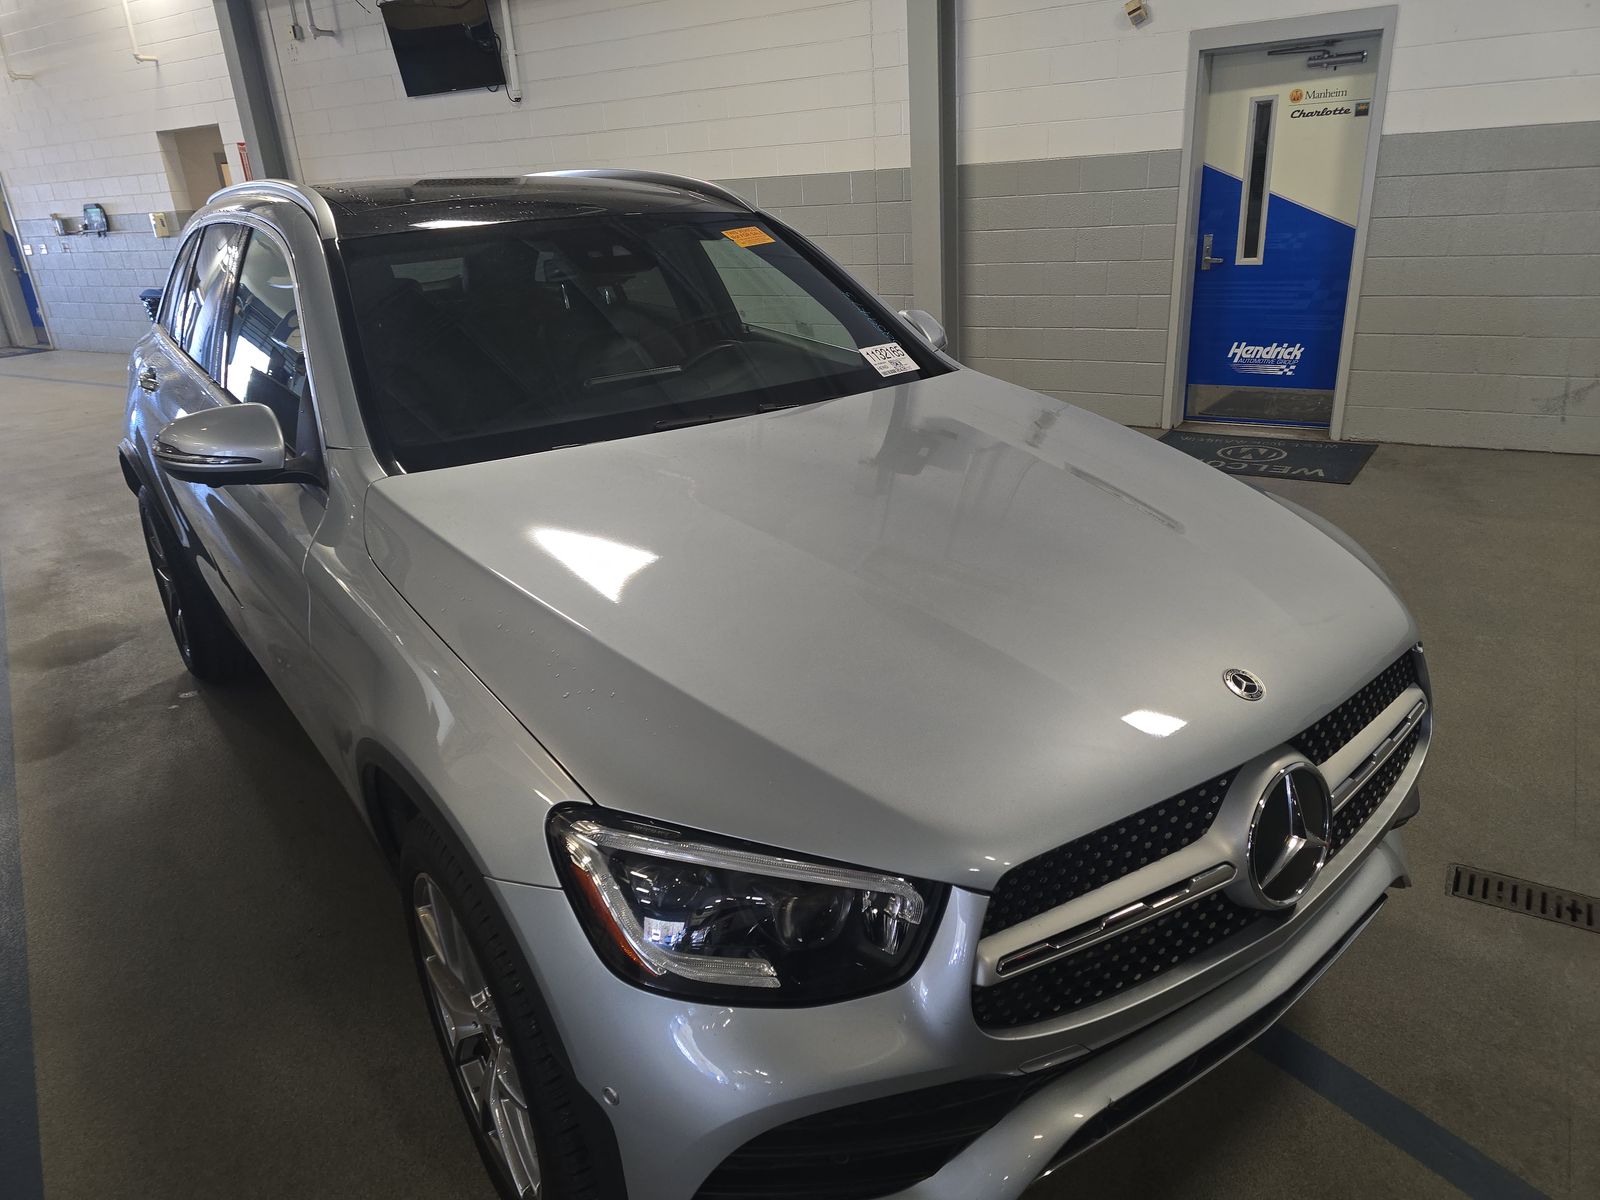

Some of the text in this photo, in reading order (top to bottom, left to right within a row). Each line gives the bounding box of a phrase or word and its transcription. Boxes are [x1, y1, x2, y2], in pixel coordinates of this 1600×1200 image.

[1305, 88, 1347, 100] Manheim
[1290, 107, 1352, 118] Charlotte
[866, 345, 905, 362] 1132165
[1227, 342, 1304, 363] Hendrick
[1200, 459, 1325, 477] WELCO
